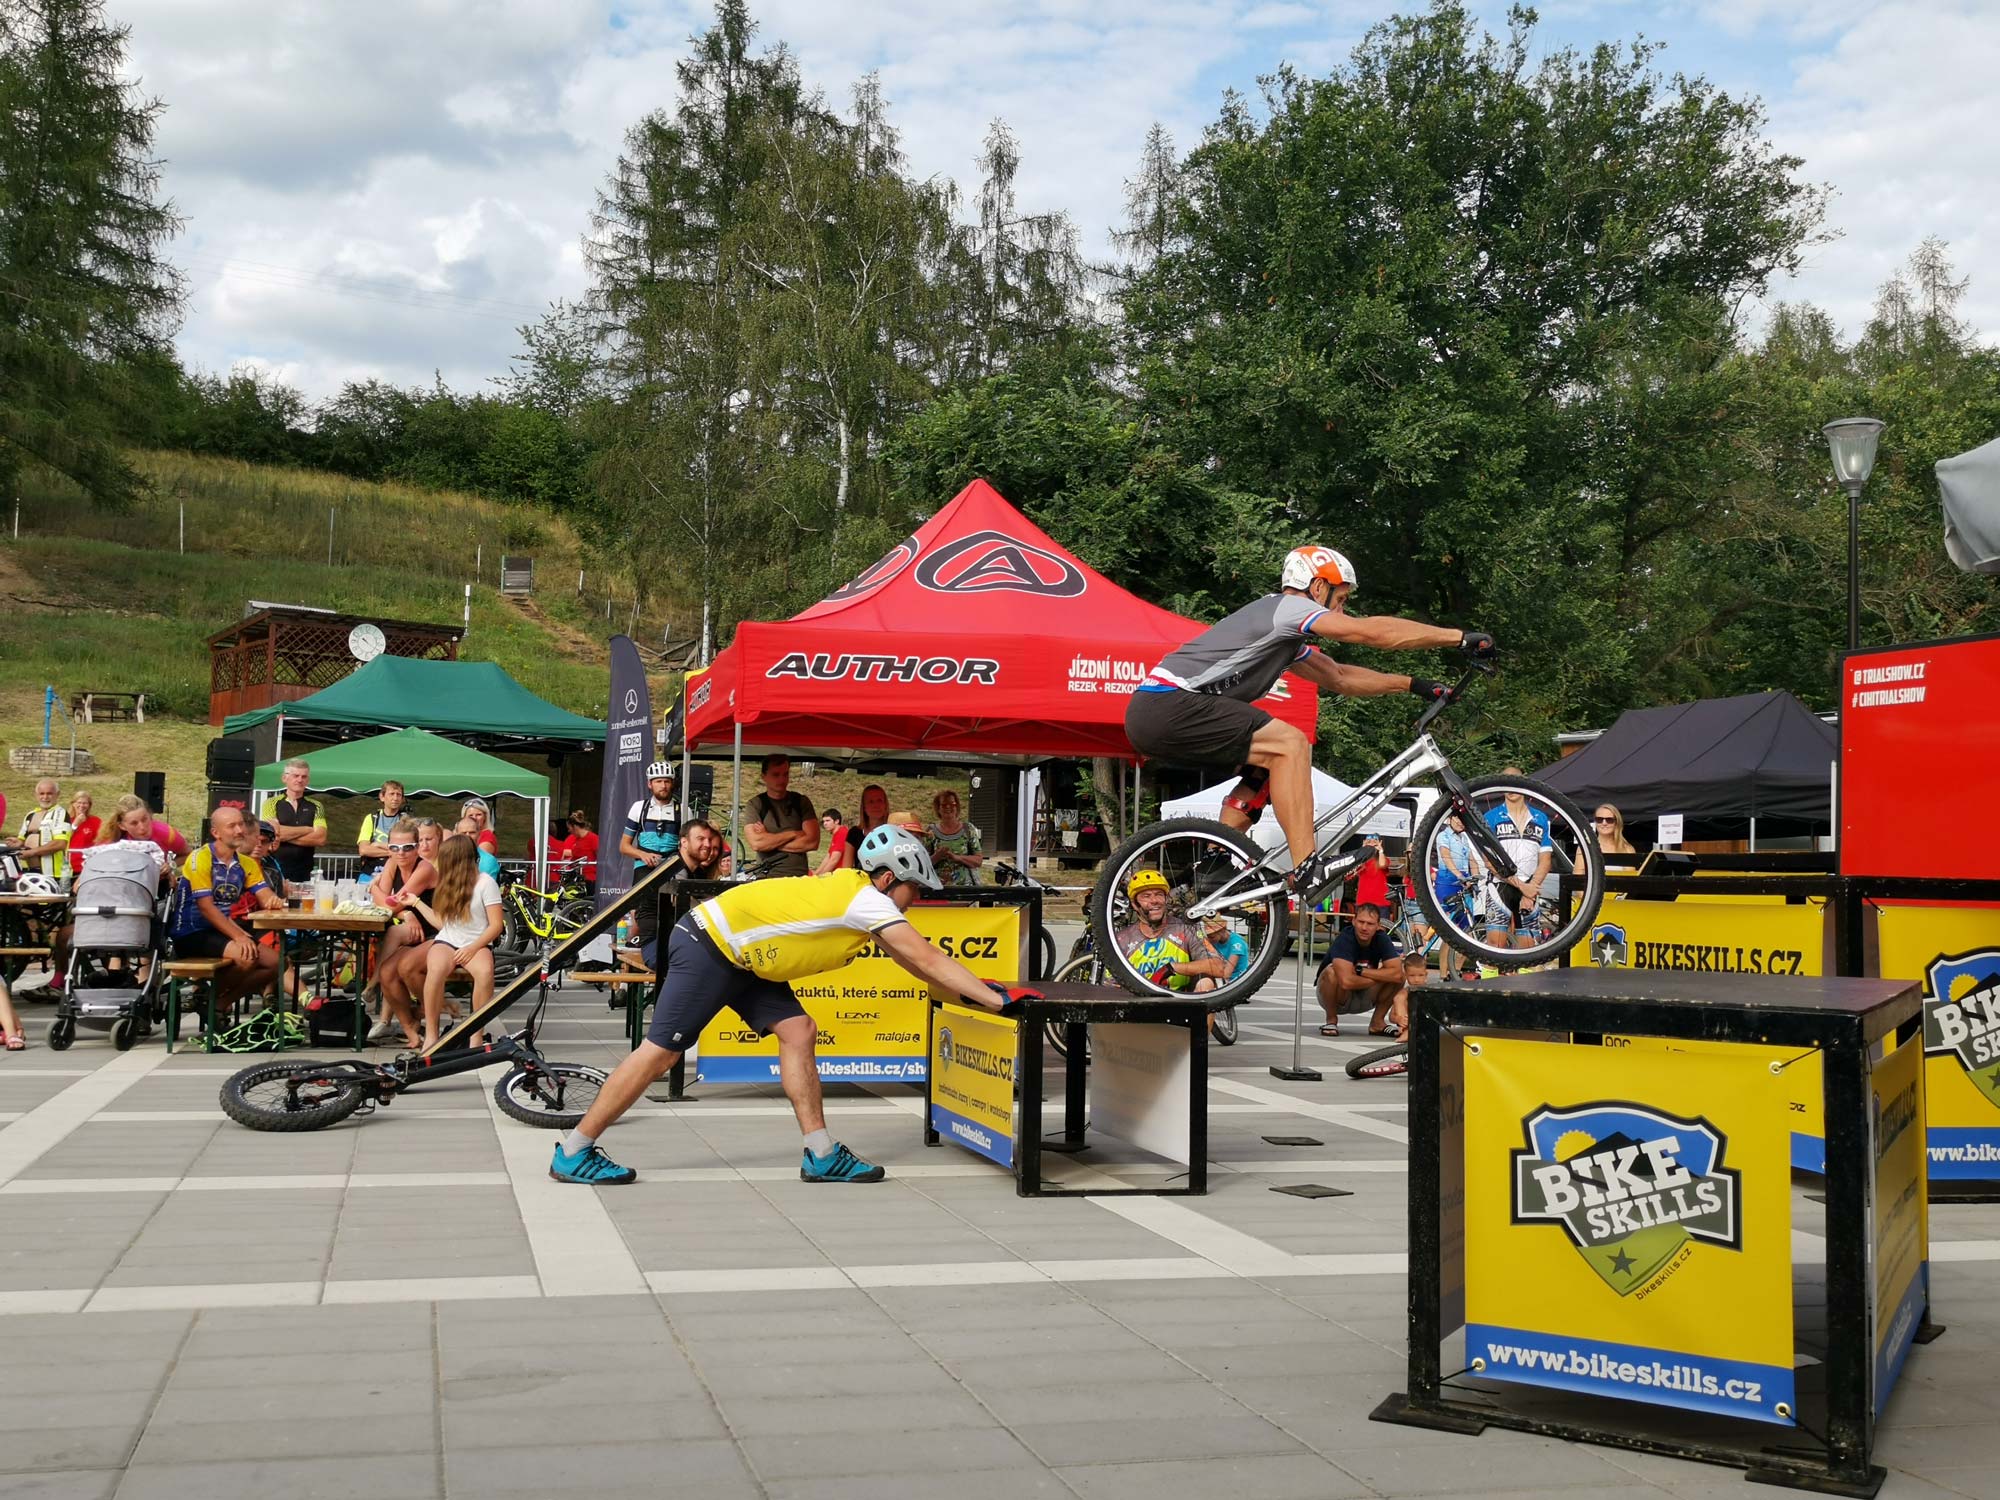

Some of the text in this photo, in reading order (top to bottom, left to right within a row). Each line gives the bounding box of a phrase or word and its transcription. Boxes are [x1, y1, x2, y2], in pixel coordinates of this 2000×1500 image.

[766, 652, 1000, 684] AUTHOR
[1068, 653, 1146, 681] JÍZDNÍ KOLA
[1863, 663, 1926, 684] TRIALSHOW.CZ
[1068, 681, 1097, 693] REZEK
[1634, 941, 1804, 976] BIKESKILLS.CZ
[842, 986, 878, 999] které
[881, 988, 915, 999] sami
[836, 1011, 881, 1019] LEZYNE
[719, 1031, 760, 1043] DVO
[874, 1032, 912, 1043] maloja
[955, 1043, 1013, 1081] BIKESKILLS.CZ
[1532, 1135, 1692, 1216] BIKE
[1586, 1180, 1722, 1240] SKILLS
[1634, 1247, 1693, 1301] bikeskills.cz
[1487, 1343, 1762, 1401] www.bikeskills.cz
